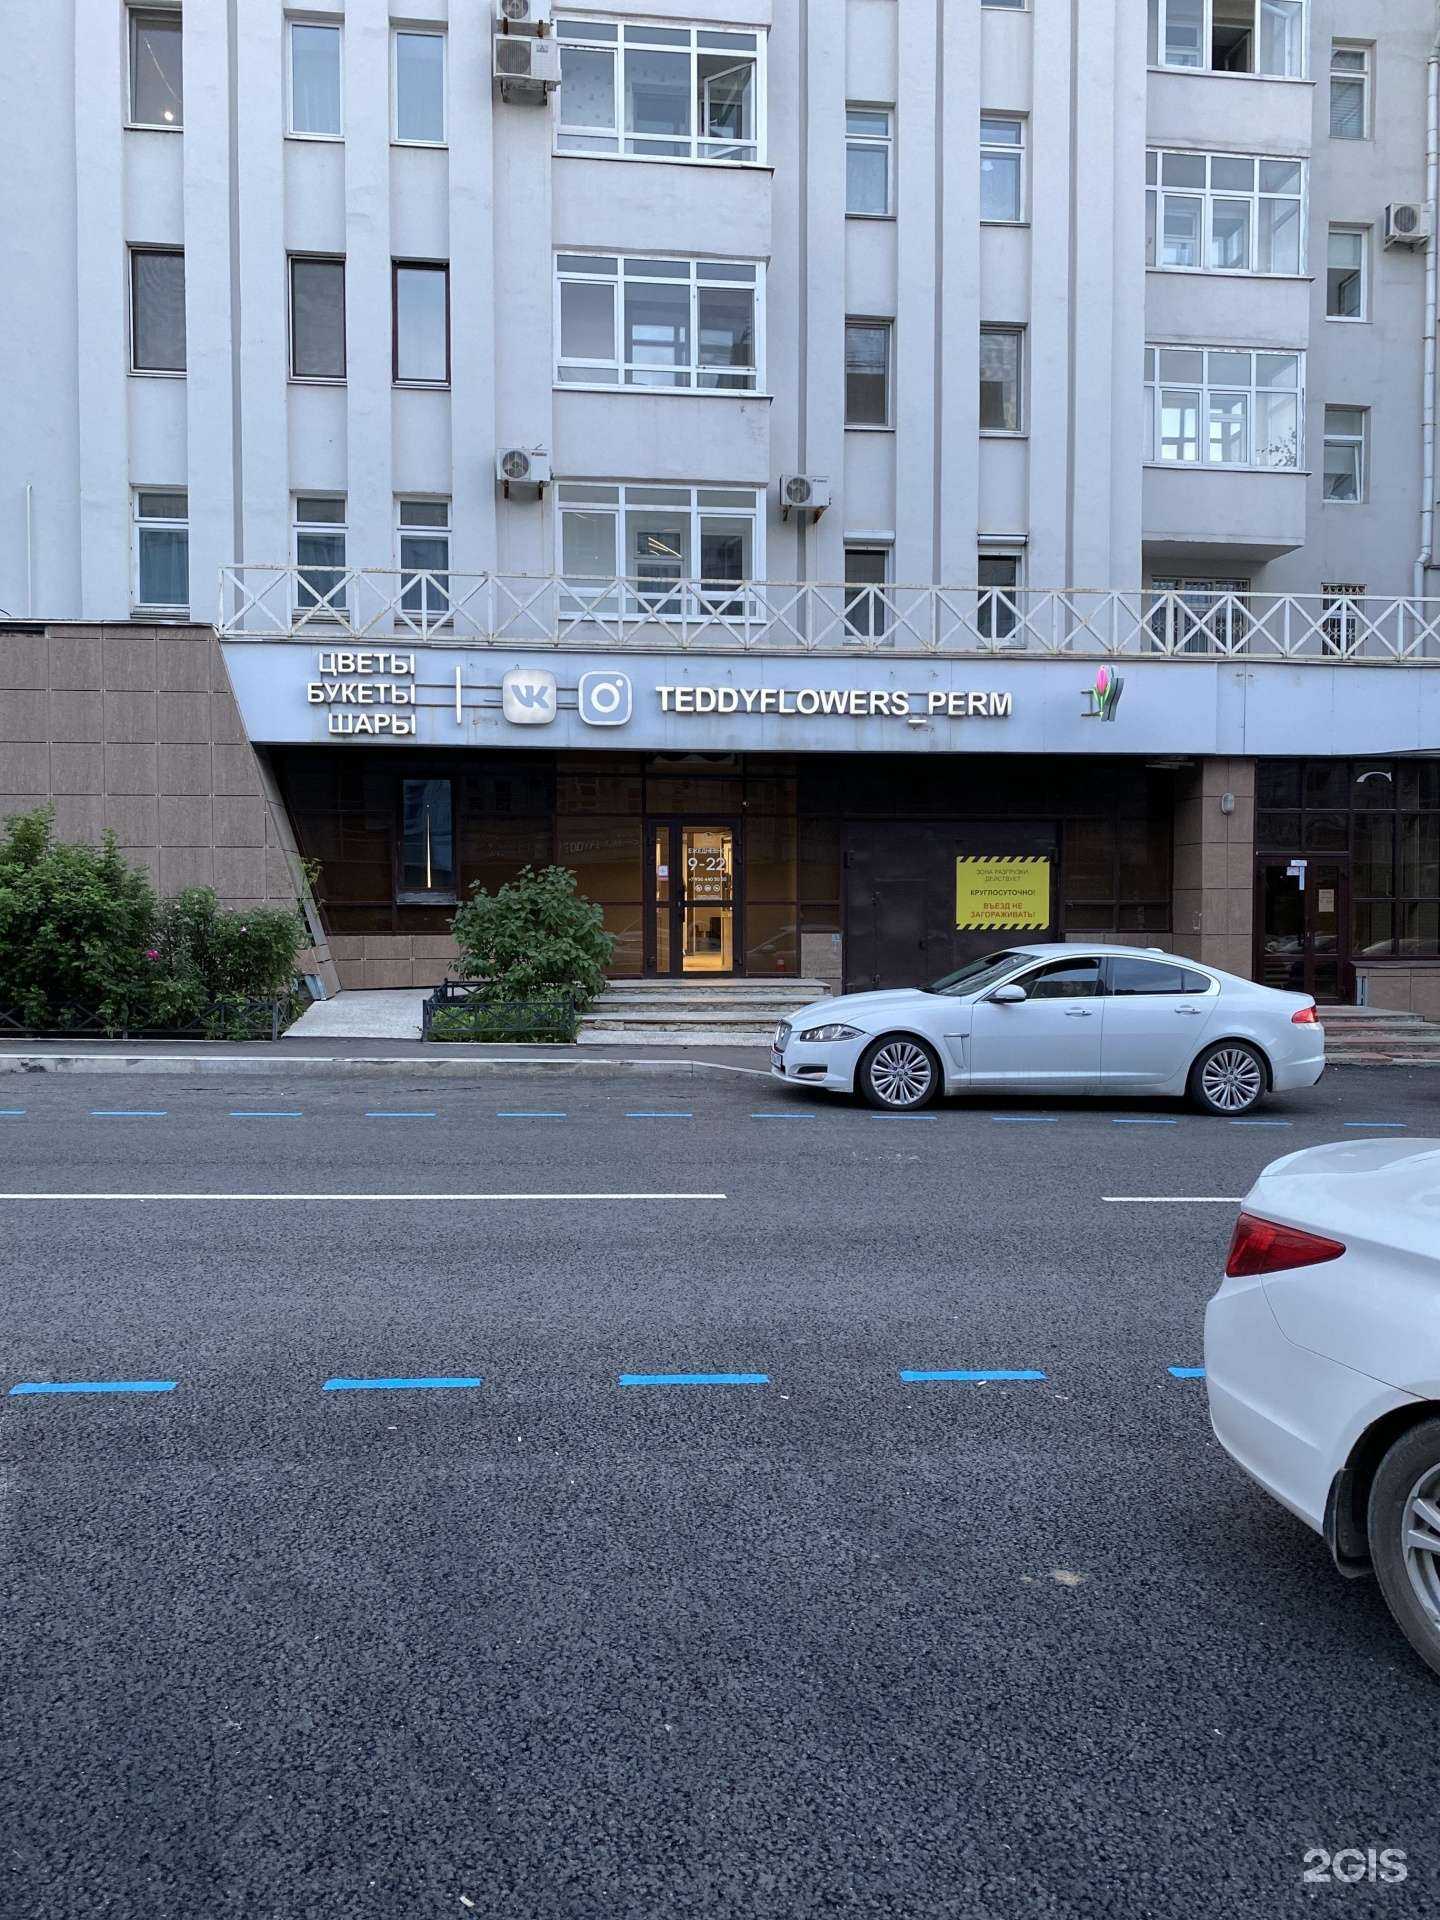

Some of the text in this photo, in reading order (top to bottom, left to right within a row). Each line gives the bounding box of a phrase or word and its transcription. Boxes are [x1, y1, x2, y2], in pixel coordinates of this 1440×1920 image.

[319, 652, 415, 676] ЦВЕТЫ
[307, 682, 416, 704] БУКЕТЫ
[328, 712, 416, 734] ШАРЫ
[688, 857, 726, 871] 9-22
[983, 902, 1024, 910] ВЪЕЗД НЕ
